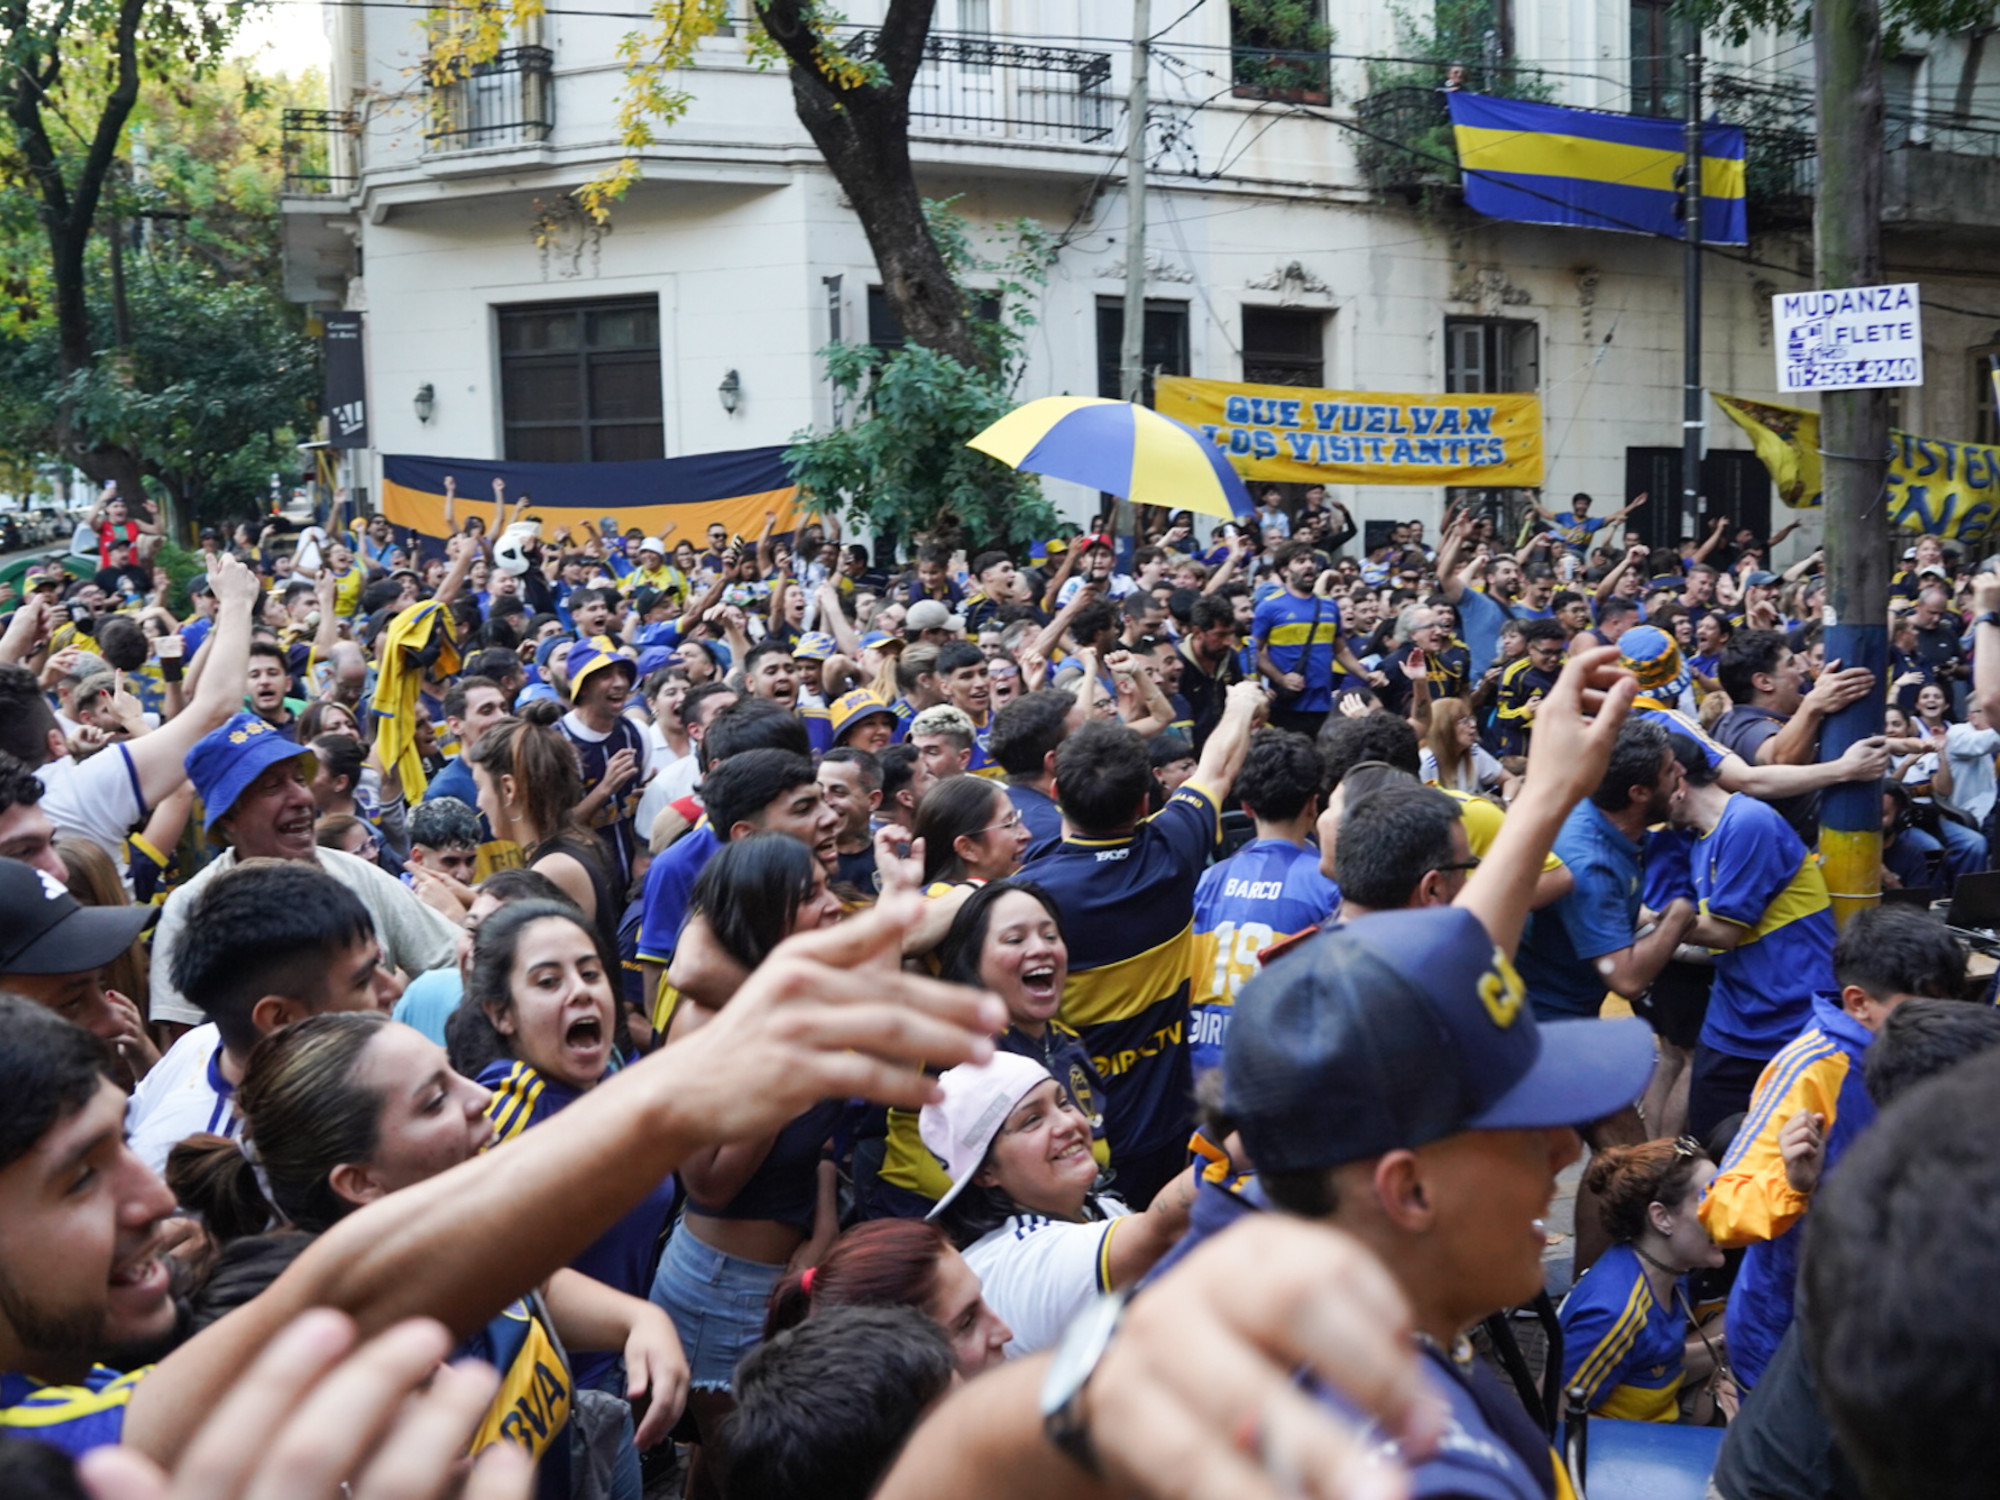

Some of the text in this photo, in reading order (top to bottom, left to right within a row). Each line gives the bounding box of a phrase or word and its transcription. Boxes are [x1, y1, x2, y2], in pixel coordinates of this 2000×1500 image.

[1783, 288, 1914, 319] MUDANZA
[1836, 322, 1914, 345] FLETE
[1789, 359, 1917, 387] 11-2563-9240
[1224, 394, 1497, 436] QUE VUELVAN
[1201, 424, 1506, 467] LOS VISITANTES
[1901, 434, 2000, 491] ISTEN
[1224, 878, 1283, 900] BARCO
[1211, 920, 1273, 997] 19
[1092, 1020, 1182, 1078] DIRCTV
[484, 1360, 567, 1455] BVA
